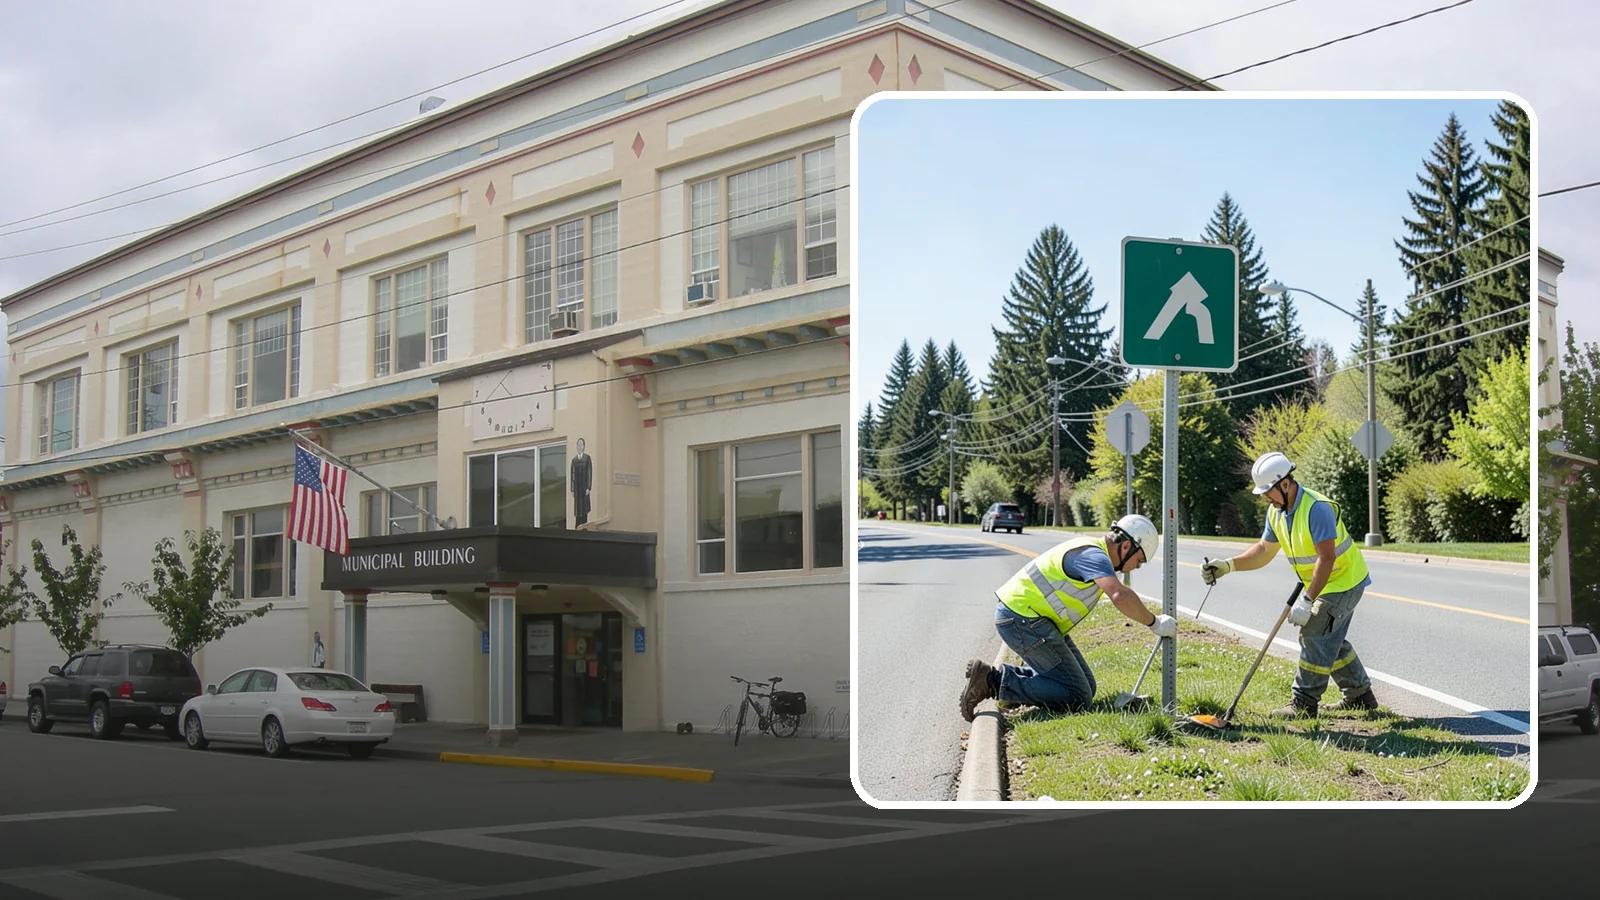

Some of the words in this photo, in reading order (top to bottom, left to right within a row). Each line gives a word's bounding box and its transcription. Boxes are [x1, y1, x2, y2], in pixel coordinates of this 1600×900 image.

[536, 402, 540, 410] 4
[480, 407, 484, 415] 8
[488, 418, 492, 426] 9
[529, 414, 533, 422] 3
[494, 424, 500, 432] 10
[521, 420, 526, 428] 2
[508, 425, 513, 433] 12
[342, 553, 405, 572] MUNICIPAL
[414, 546, 474, 567] BUILDING
